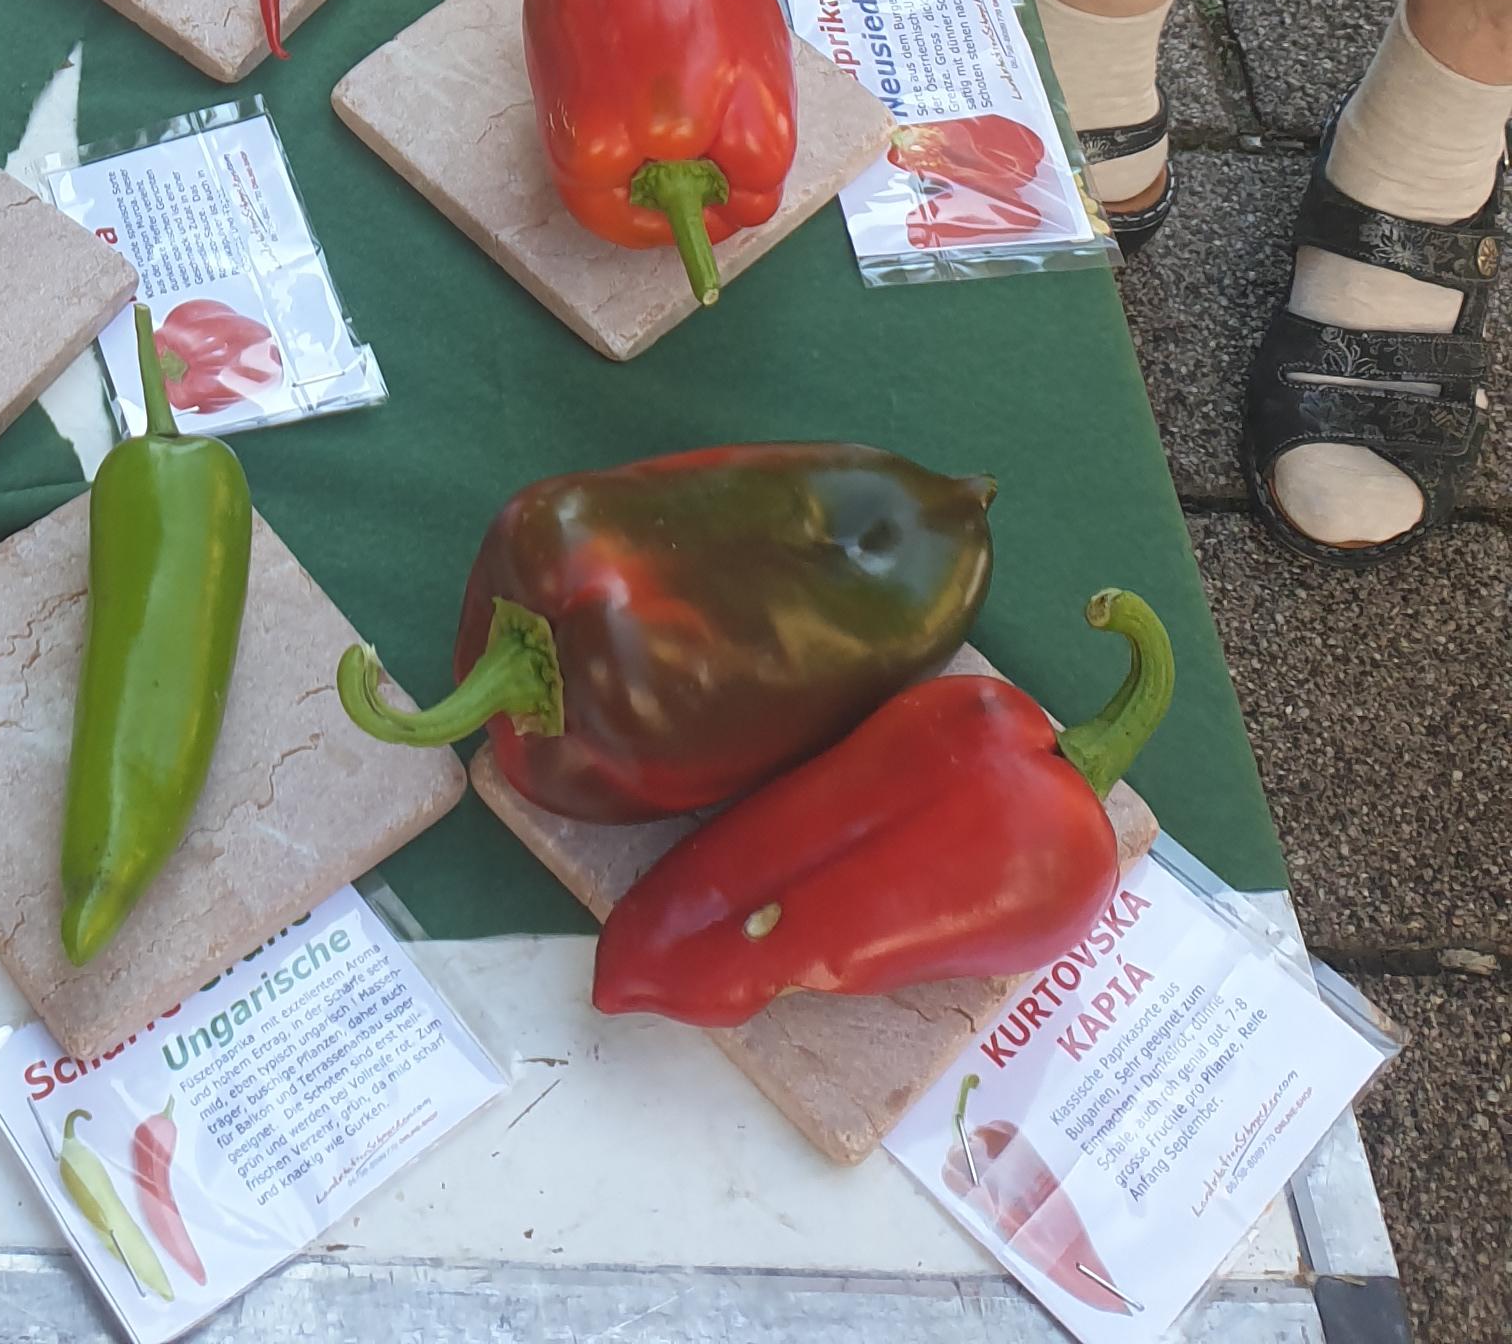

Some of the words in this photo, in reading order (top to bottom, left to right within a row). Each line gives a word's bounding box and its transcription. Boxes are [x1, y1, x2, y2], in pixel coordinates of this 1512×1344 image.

[942, 14, 959, 53] dünner
[953, 57, 966, 75] mit
[961, 22, 978, 59] stehen
[961, 80, 976, 108] saftig
[974, 64, 992, 106] Schoten
[159, 931, 351, 1071] Ungarische
[982, 887, 1147, 1066] KURTOVSKA
[1058, 957, 1151, 1059] KAPIÁ
[205, 1103, 248, 1133] träger,
[245, 1064, 296, 1103] buschige
[295, 1029, 347, 1066] Pflanzen,
[345, 1003, 379, 1029] daher
[380, 980, 405, 1005] auch
[215, 1131, 234, 1148] für
[232, 1102, 273, 1134] Balkon
[274, 1081, 297, 1104] und
[296, 1019, 383, 1086] Terrassenanbau
[383, 996, 414, 1021] super
[1048, 1069, 1103, 1125] Klassische
[1098, 1003, 1162, 1069] Paprikasorte
[1160, 983, 1180, 1004] aus
[1064, 1087, 1120, 1140] Bulgarien,
[1113, 1057, 1141, 1084] Sehr
[1140, 1008, 1183, 1060] geeignet
[1181, 985, 1205, 1011] zum
[1095, 1131, 1138, 1170] Schale,
[1134, 1096, 1161, 1128] auch
[1158, 1076, 1179, 1100] roh
[1176, 1041, 1209, 1082] genial
[1206, 1021, 1229, 1048] gut.
[1224, 996, 1248, 1021] 7-8
[1114, 1146, 1149, 1188] grosse
[1184, 1082, 1204, 1107] pro
[1198, 1042, 1244, 1084] Pflanze,
[1237, 1009, 1268, 1039] Reife
[256, 1181, 278, 1205] und
[276, 1150, 324, 1187] knackig
[323, 1133, 343, 1152] wie
[341, 1101, 388, 1136] Gurken.
[1127, 1159, 1170, 1201] Anfang
[1162, 1098, 1224, 1160] September.
